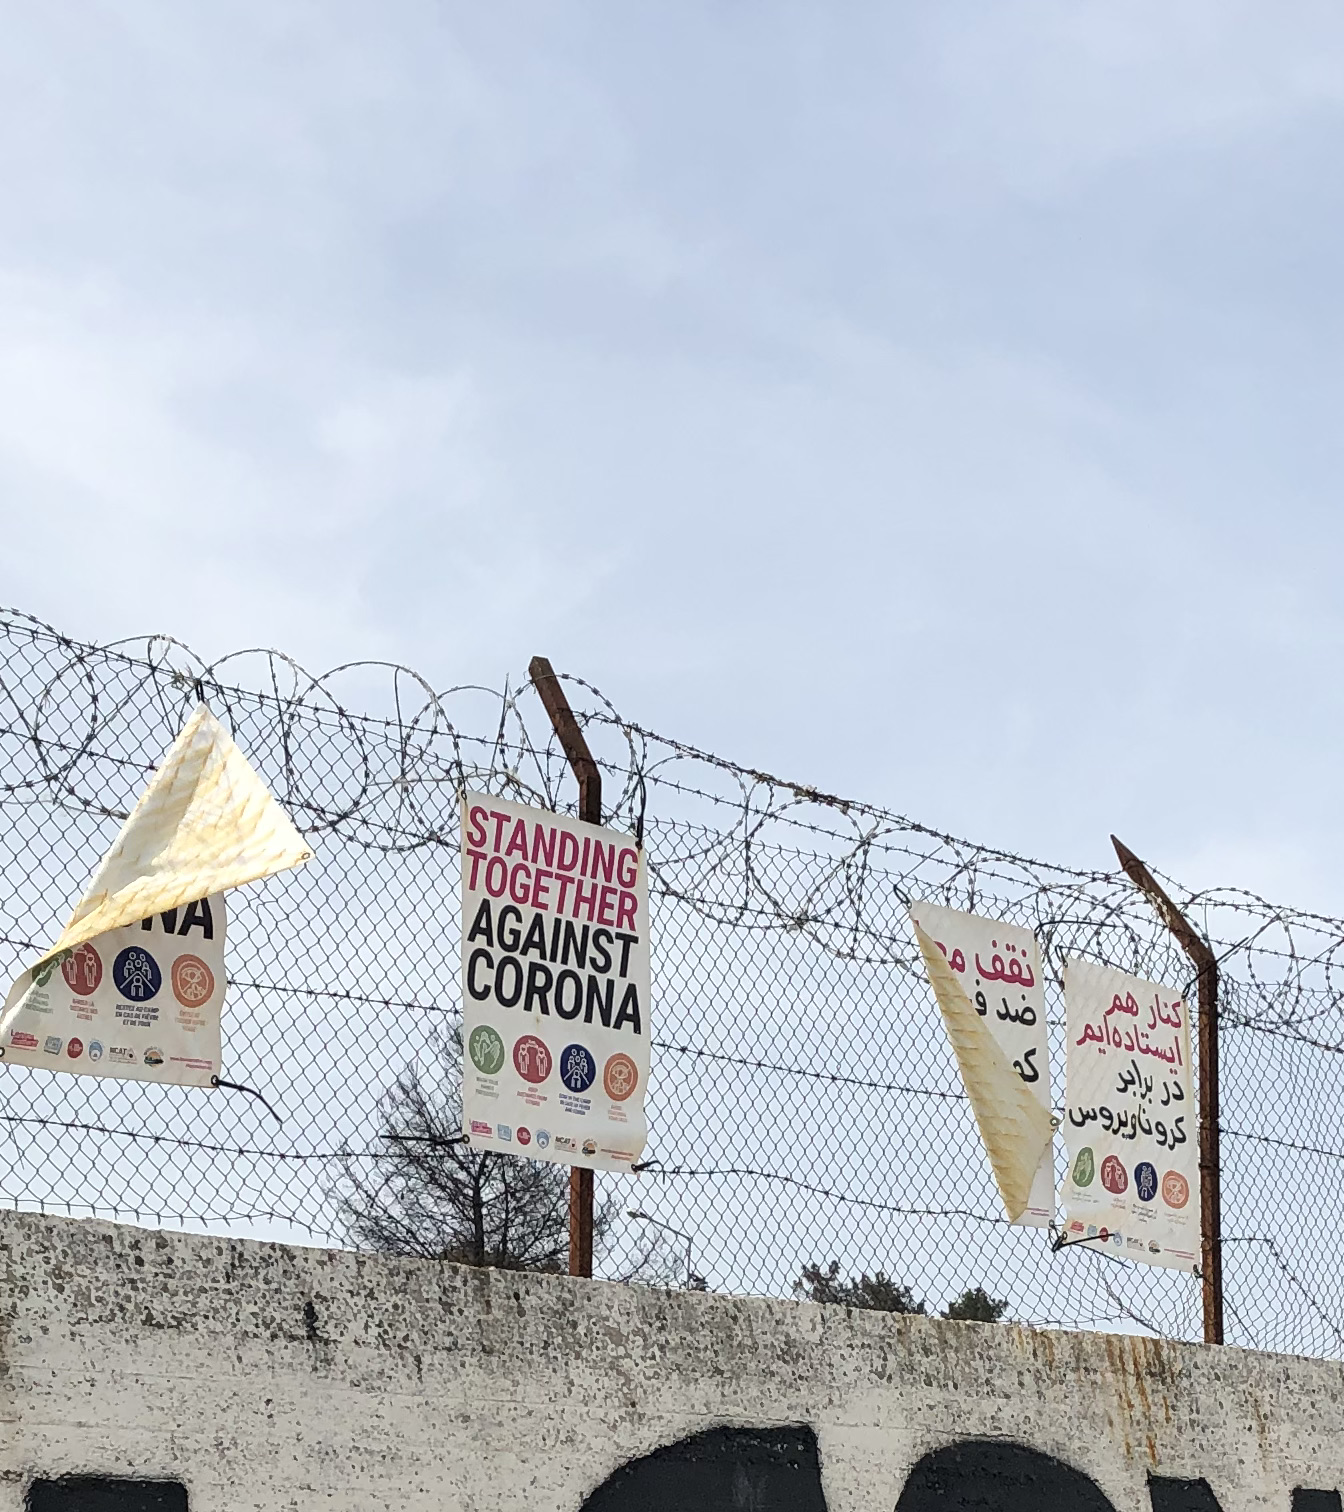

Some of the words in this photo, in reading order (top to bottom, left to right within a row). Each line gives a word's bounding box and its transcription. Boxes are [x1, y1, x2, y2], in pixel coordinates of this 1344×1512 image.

[466, 805, 639, 889] STANDING
[466, 848, 639, 932] TOGETHER
[467, 898, 639, 979] AGAINST
[975, 939, 1035, 988] نقف
[467, 947, 642, 1035] CORONA
[996, 993, 1037, 1026] ضد
[1105, 991, 1139, 1017] هم
[1160, 1080, 1185, 1106] در
